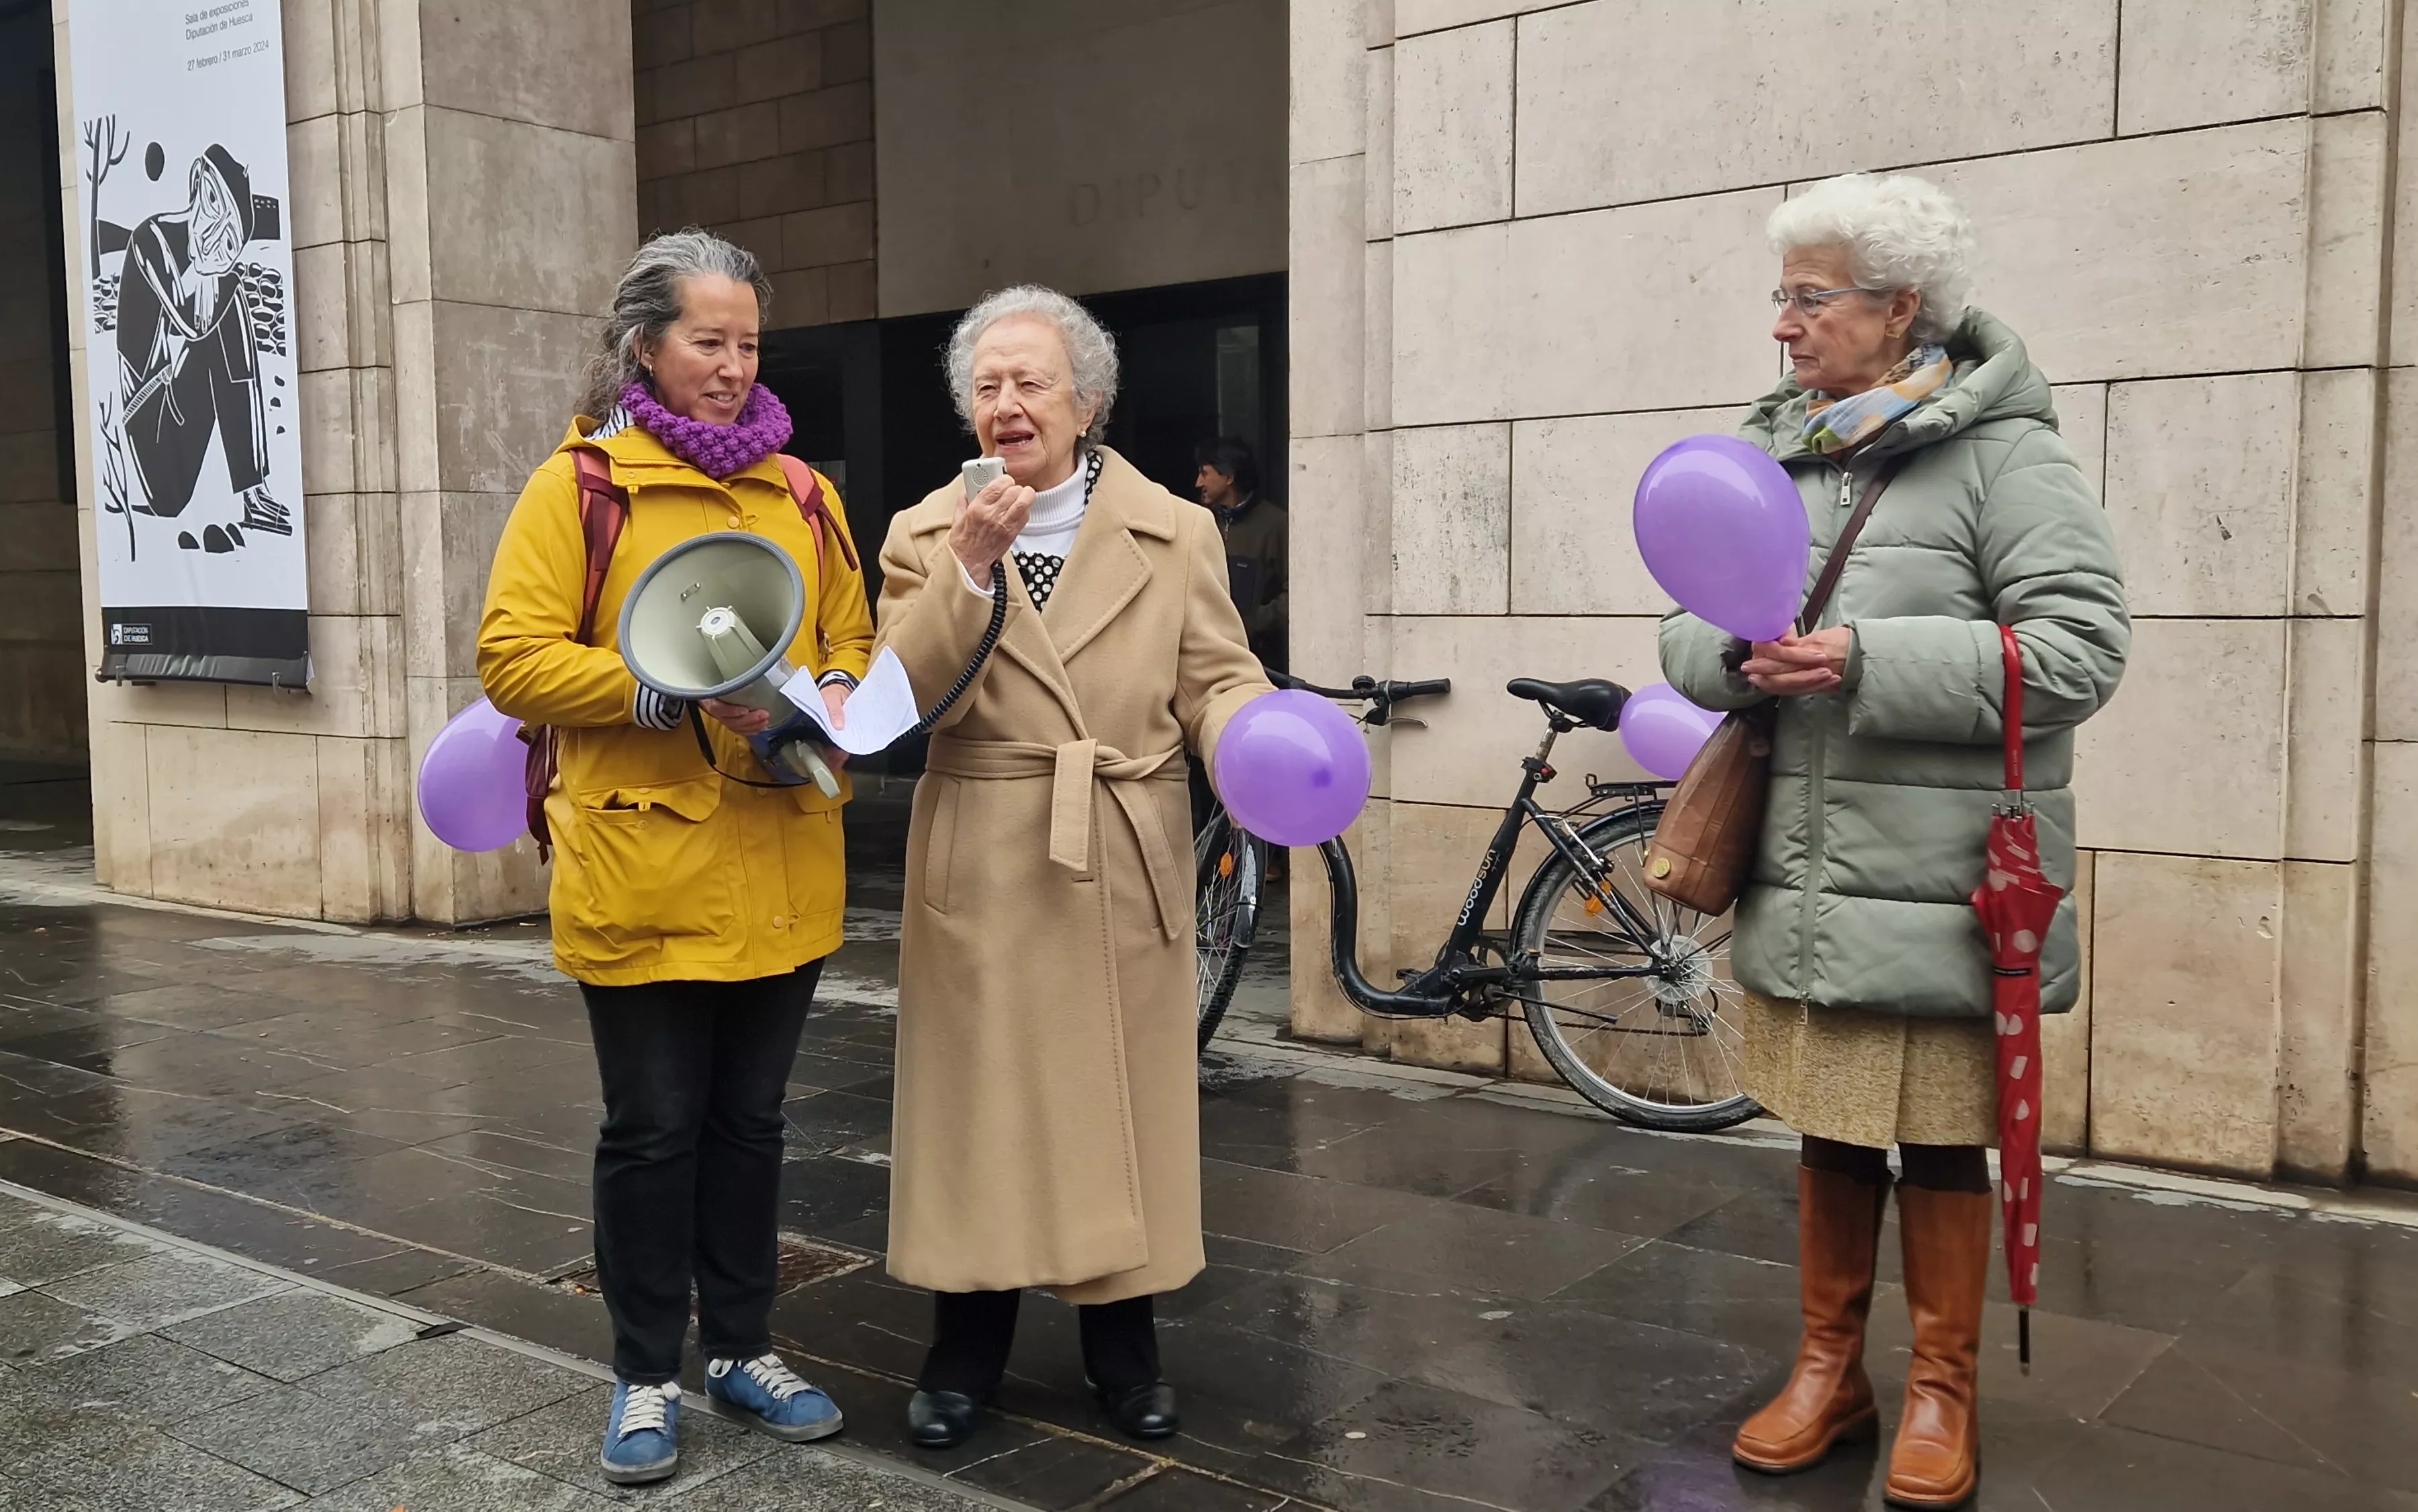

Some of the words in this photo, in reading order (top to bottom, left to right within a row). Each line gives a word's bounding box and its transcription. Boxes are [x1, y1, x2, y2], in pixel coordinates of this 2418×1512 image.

[185, 13, 198, 25] Sala
[199, 9, 207, 20] de
[209, 0, 249, 18] exposiciones
[220, 19, 228, 30] de
[229, 13, 253, 27] Huesca
[187, 59, 195, 71] 27
[197, 55, 218, 68] febrero
[223, 50, 230, 62] 31
[232, 46, 252, 58] marzo
[253, 39, 269, 53] 2024
[1457, 849, 1496, 926] woodsun
